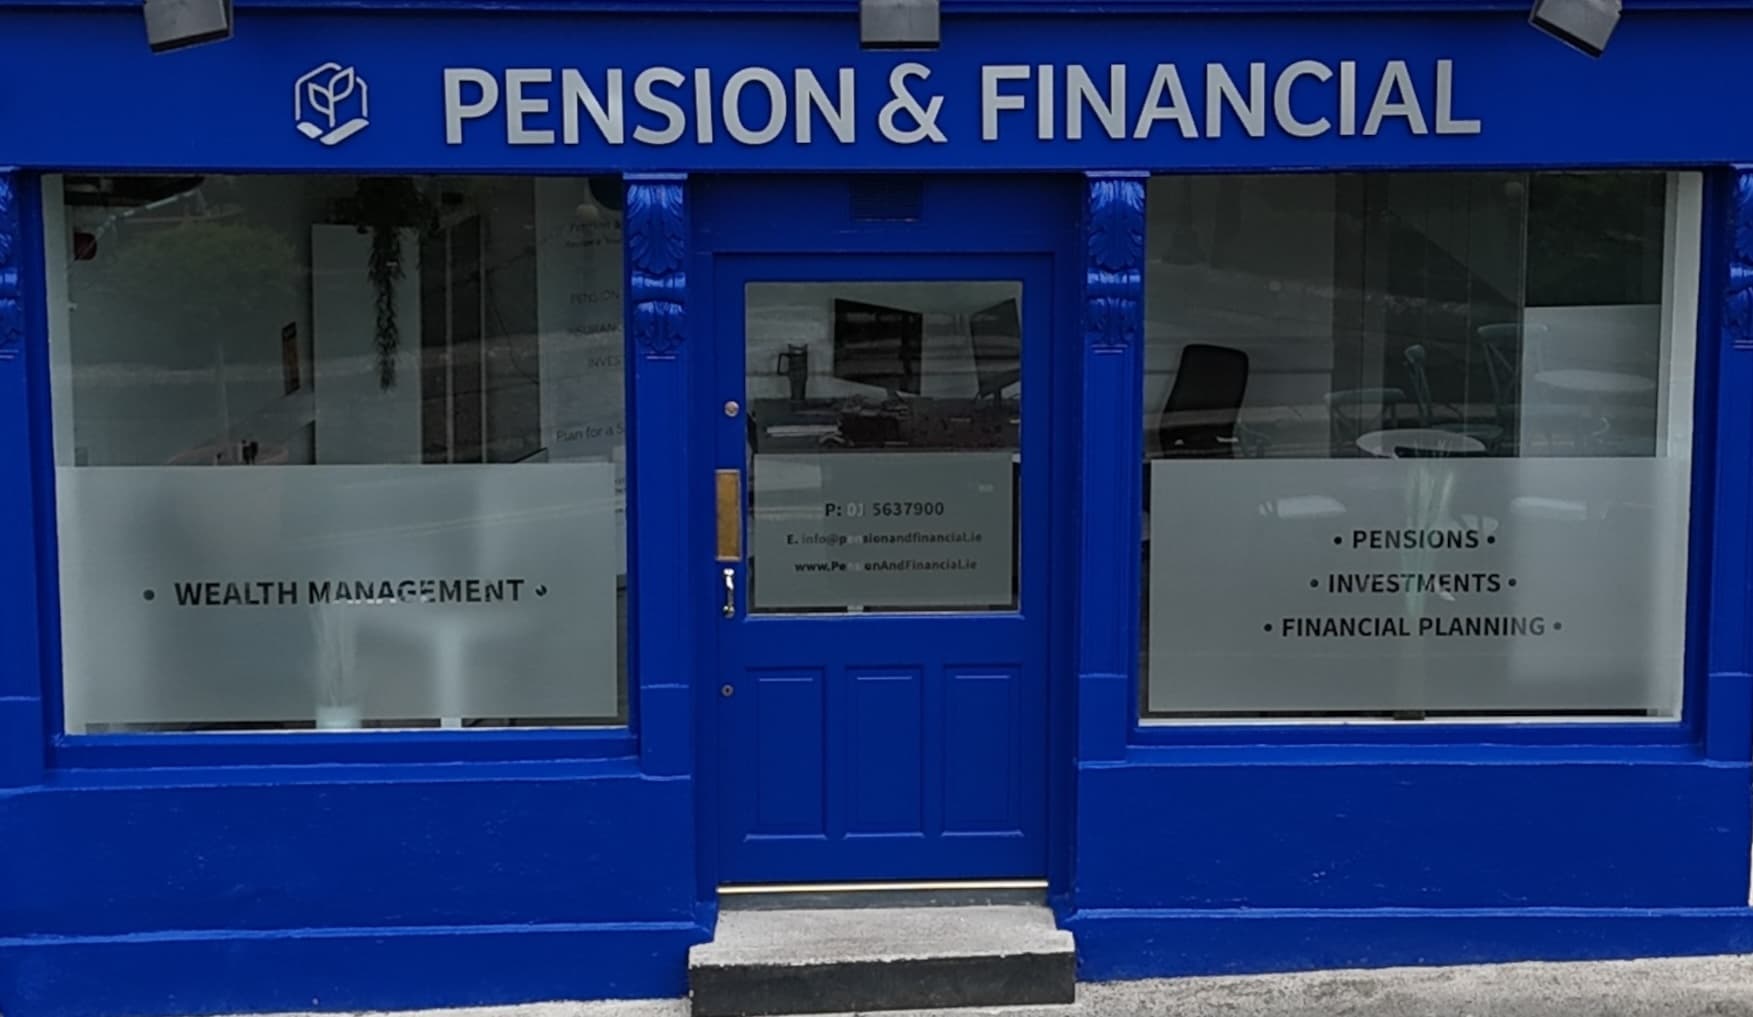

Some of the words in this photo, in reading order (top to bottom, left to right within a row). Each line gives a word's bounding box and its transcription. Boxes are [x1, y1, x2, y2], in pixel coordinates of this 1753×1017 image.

[444, 66, 856, 145] PENSION
[877, 62, 948, 144] &
[981, 59, 1482, 141] FINANCIAL
[585, 425, 603, 439] for
[824, 502, 842, 517] P:
[872, 502, 945, 517] 5637900
[786, 533, 799, 545] E.
[1352, 529, 1479, 549] PENSIONS
[174, 581, 298, 606] WEALTH
[308, 578, 525, 605] MANAGEMENT
[1328, 573, 1501, 593] INVESTMENTS
[1281, 617, 1411, 637] FINANCIAL
[1418, 616, 1545, 637] PLANNING
